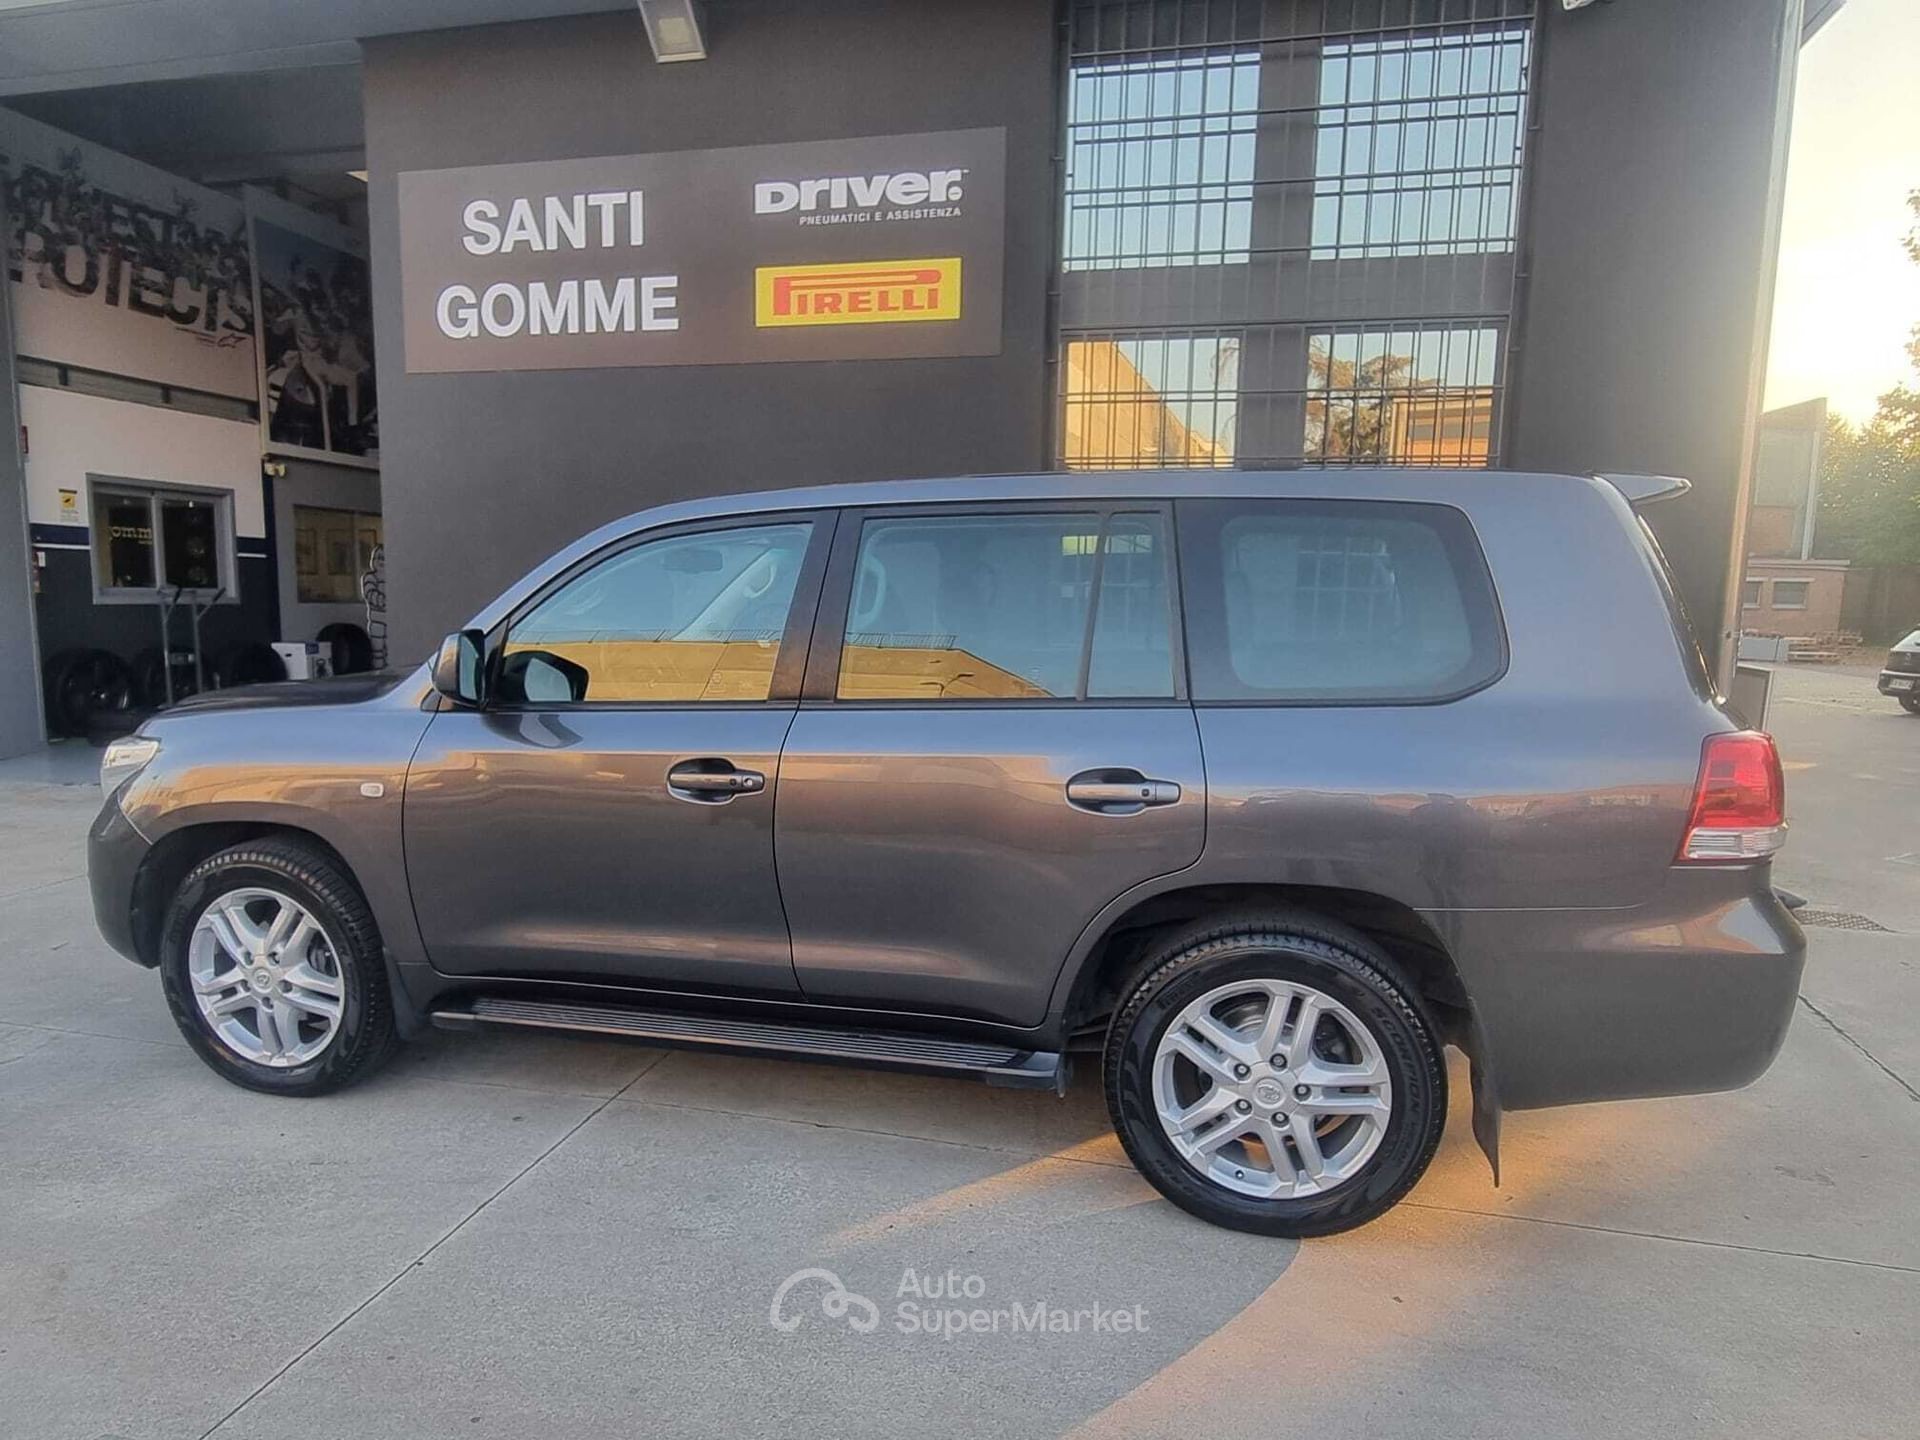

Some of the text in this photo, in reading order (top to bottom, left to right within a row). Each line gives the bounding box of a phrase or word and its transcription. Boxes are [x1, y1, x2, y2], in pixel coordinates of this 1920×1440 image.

[462, 191, 644, 255] SANTI
[799, 208, 961, 226] PNEUMATICI E ASSISTENZA
[436, 275, 679, 340] GOMME
[773, 269, 942, 316] PIRELLI
